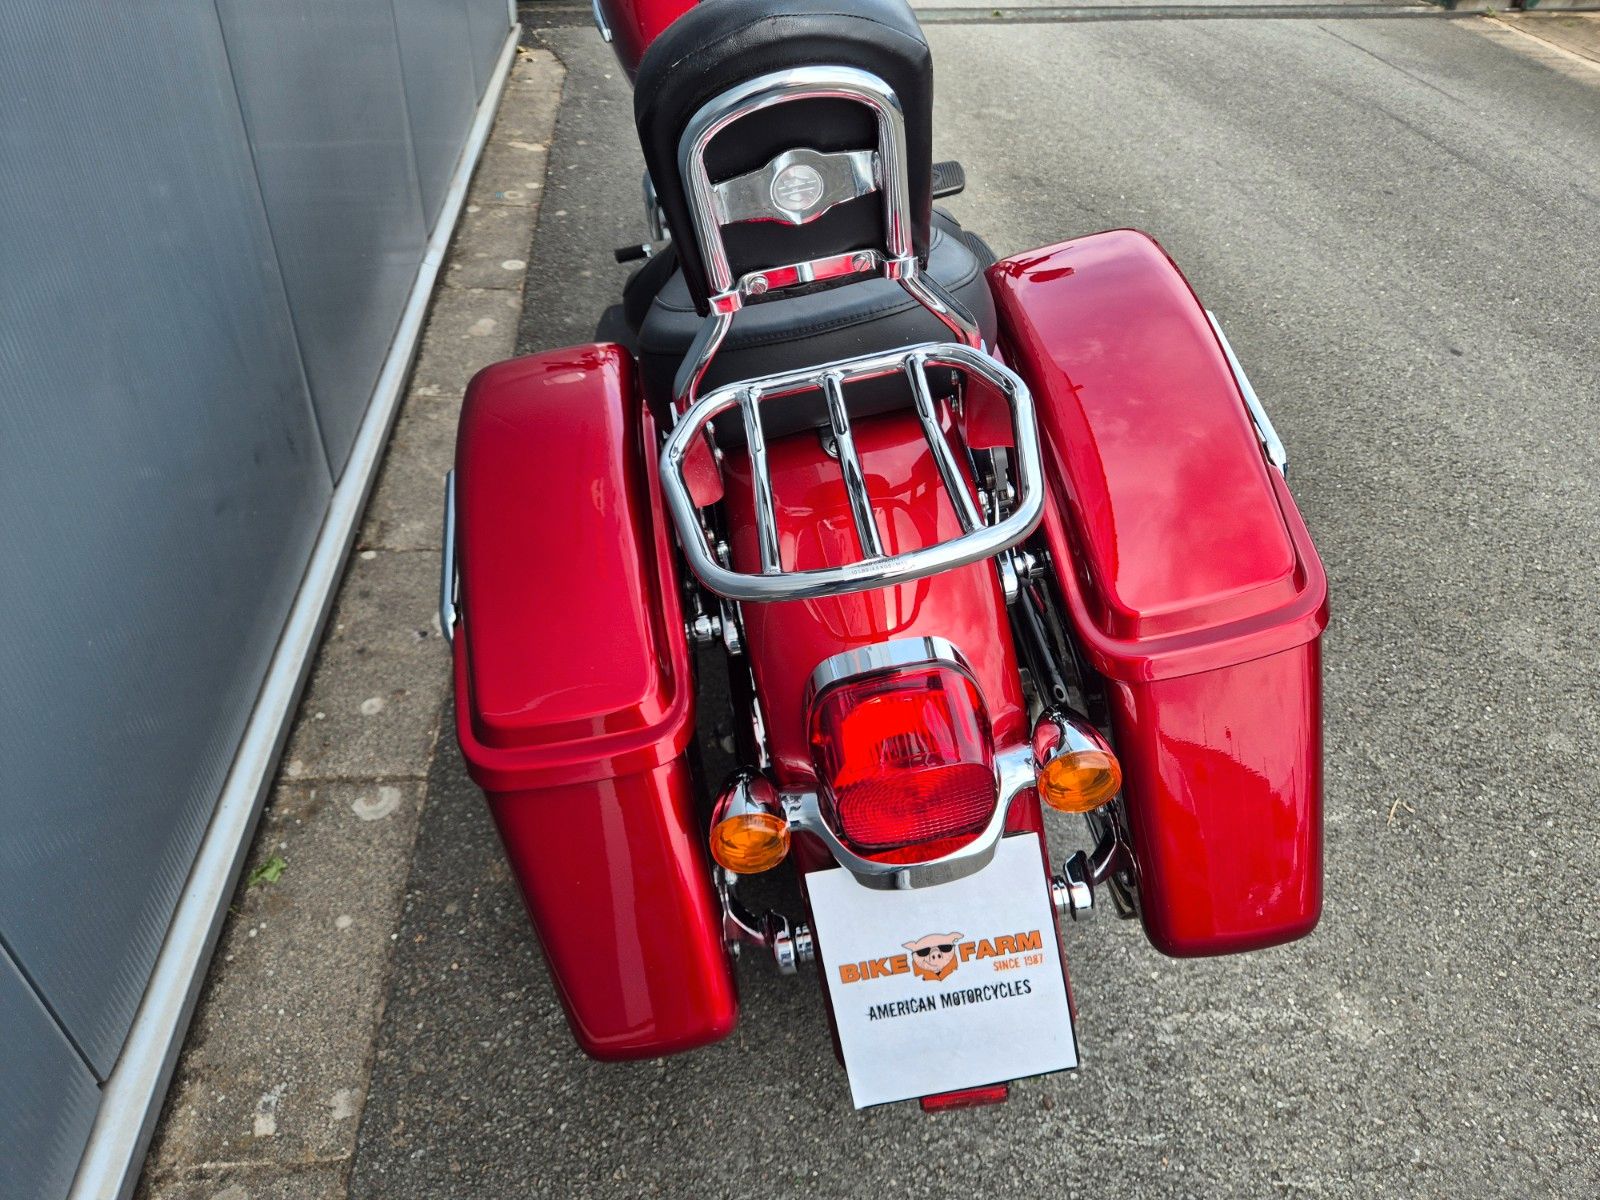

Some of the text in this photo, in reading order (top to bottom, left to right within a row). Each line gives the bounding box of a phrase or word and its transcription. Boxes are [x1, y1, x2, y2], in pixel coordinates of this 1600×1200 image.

[839, 930, 1043, 984] BIKE FARM
[993, 953, 1045, 972] SINCE 1987
[868, 979, 1032, 1021] AMERICAN MOTORCYCLES
